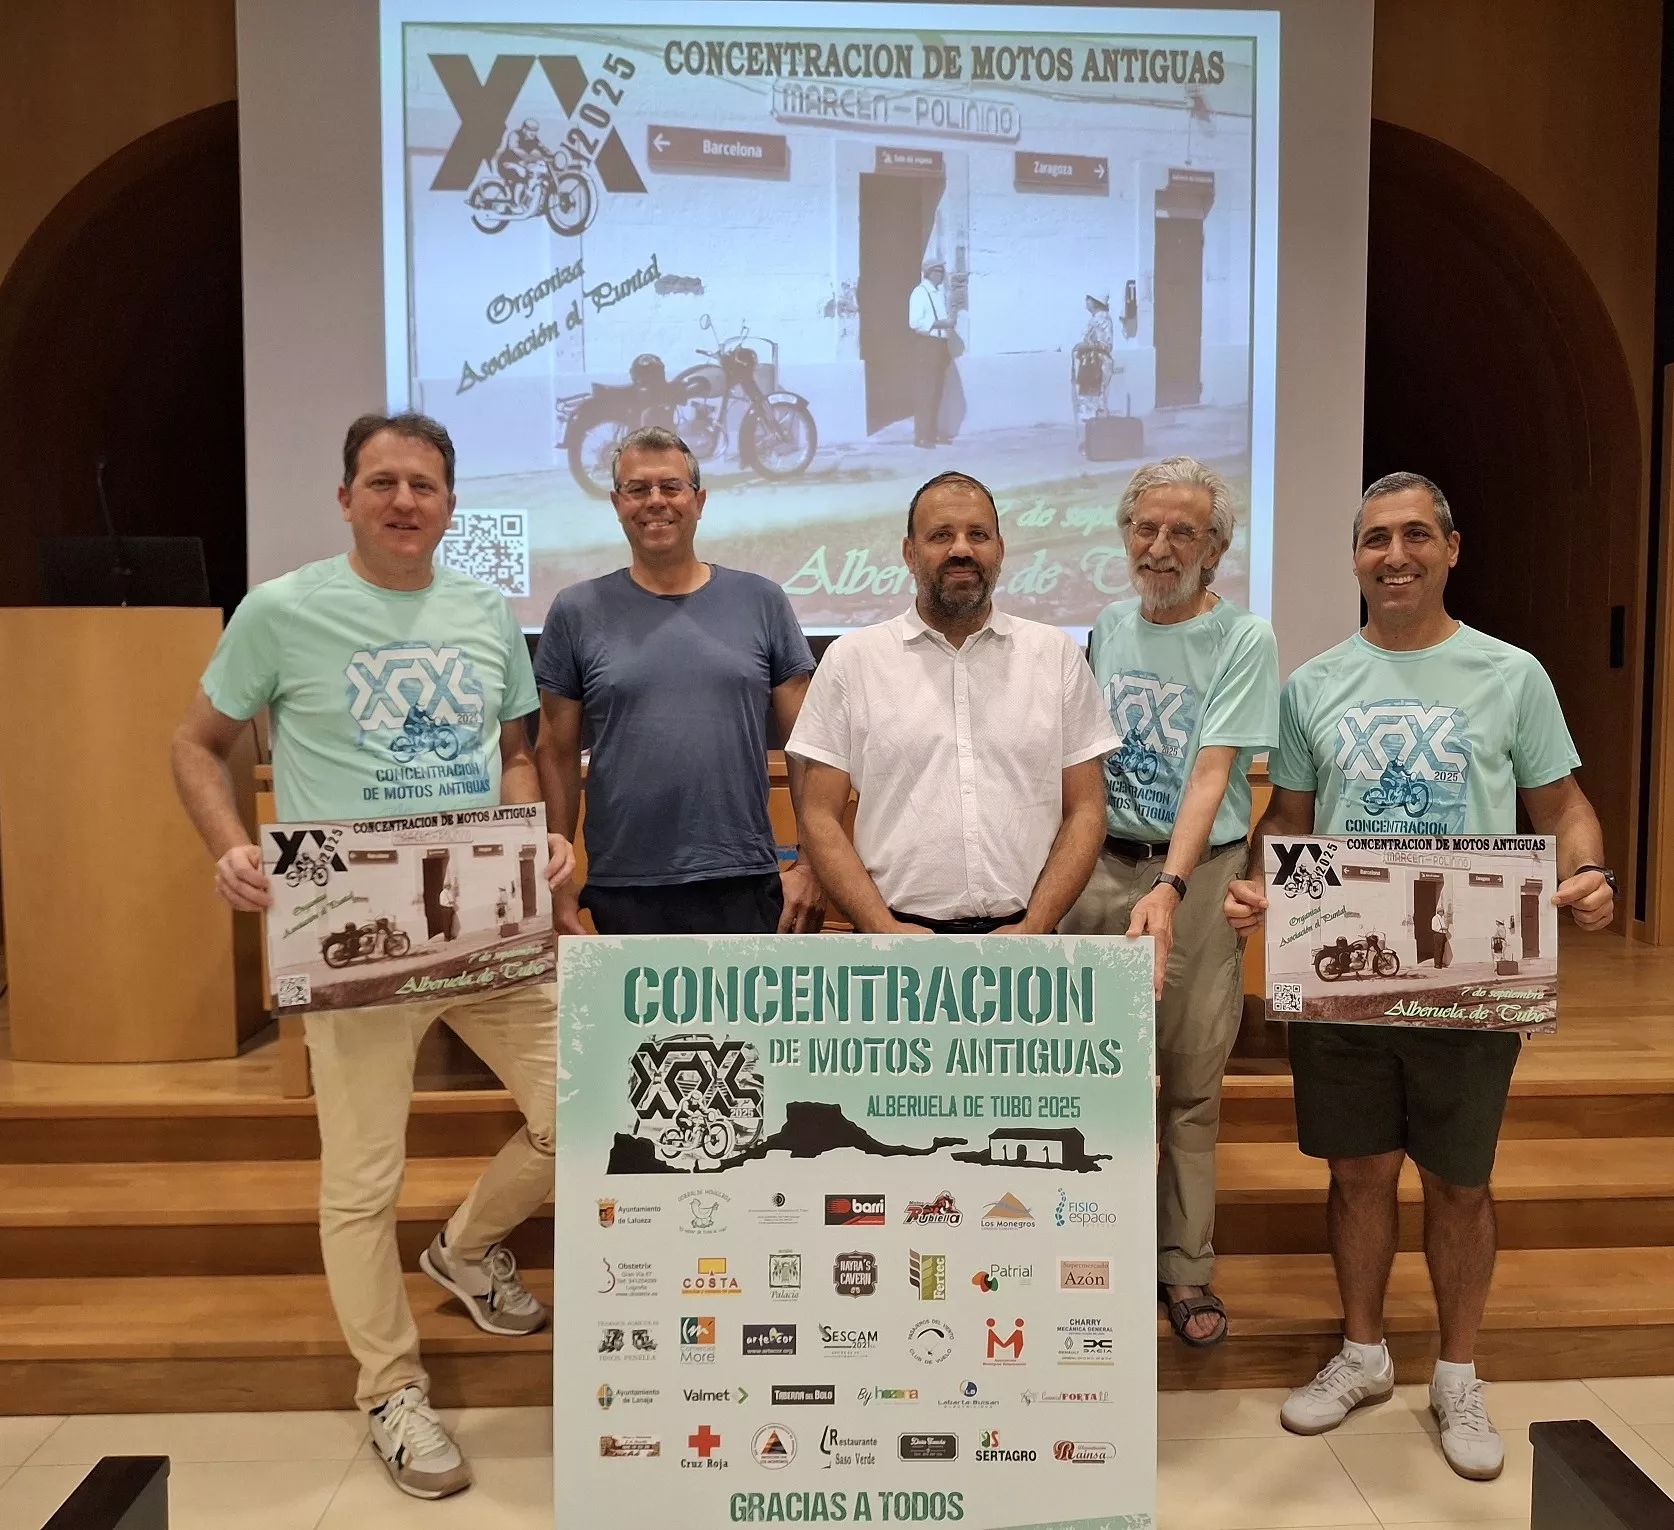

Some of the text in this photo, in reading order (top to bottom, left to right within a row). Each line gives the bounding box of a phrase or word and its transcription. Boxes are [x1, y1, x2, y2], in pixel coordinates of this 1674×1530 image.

[664, 40, 1226, 85] CONCENTRACION DE MOTOS ANTIGUAS
[568, 52, 637, 166] 2025
[703, 138, 763, 158] Barcelona
[1033, 159, 1073, 177] Zaragoza
[485, 258, 585, 324] Organiza
[456, 321, 560, 396] Asociación
[565, 300, 584, 332] el
[1016, 498, 1057, 528] de
[781, 545, 918, 595] Alber
[1008, 548, 1063, 595] de
[1161, 745, 1179, 757] 2025
[376, 763, 480, 783] CONCENTRACION
[1433, 771, 1459, 782] 2025
[363, 778, 491, 801] DE MOTOS ANTIGUAS
[353, 806, 537, 834] CONCENTRACION DE MOTOS ANTIGUAS
[1345, 819, 1448, 834] CONCENTRACION
[318, 828, 344, 863] 2025
[1346, 838, 1546, 851] CONCENTRACION DE MOTOS ANTIGUAS
[1315, 842, 1338, 877] 2025
[623, 965, 1097, 1027] CONCENTRACION
[1461, 986, 1545, 1001] 7 de septiembre
[1384, 998, 1546, 1023] Alberuela de Tubo
[769, 1038, 1124, 1078] DE MOTOS ANTIGUAS
[730, 1108, 754, 1118] 2025
[866, 1094, 1081, 1119] ALBERUELA DE TUBO 2025
[617, 1205, 661, 1214] Ayuntamiento
[851, 1198, 884, 1214] barri
[1068, 1201, 1098, 1212] FISIO
[617, 1216, 651, 1224] de Lalueza
[904, 1206, 961, 1225] Rubiella
[1069, 1210, 1117, 1227] espacio
[981, 1220, 1036, 1229] Los Monegros
[617, 1262, 652, 1270] Obstetrix
[990, 1264, 1034, 1278] Patrial
[1062, 1261, 1109, 1269] Supermercado
[682, 1277, 739, 1289] COSTA
[933, 1257, 946, 1300] Fertec
[1064, 1271, 1105, 1286] Azón
[1069, 1318, 1101, 1326] CHARRY
[821, 1325, 878, 1343] SESCAM
[909, 1348, 922, 1362] CLUB
[616, 1389, 660, 1398] Ayuntamiento
[683, 1388, 730, 1402] Valmet
[857, 1387, 873, 1406] By
[1062, 1392, 1098, 1401] PORTA
[829, 1428, 878, 1446] Restaurante
[835, 1452, 876, 1465] Saso Verde
[975, 1450, 1037, 1462] SERTAGRO
[1054, 1440, 1107, 1461] Rainsa
[680, 1458, 729, 1470] Cruz Roja
[730, 1491, 964, 1522] GRACIAS A TODOS
